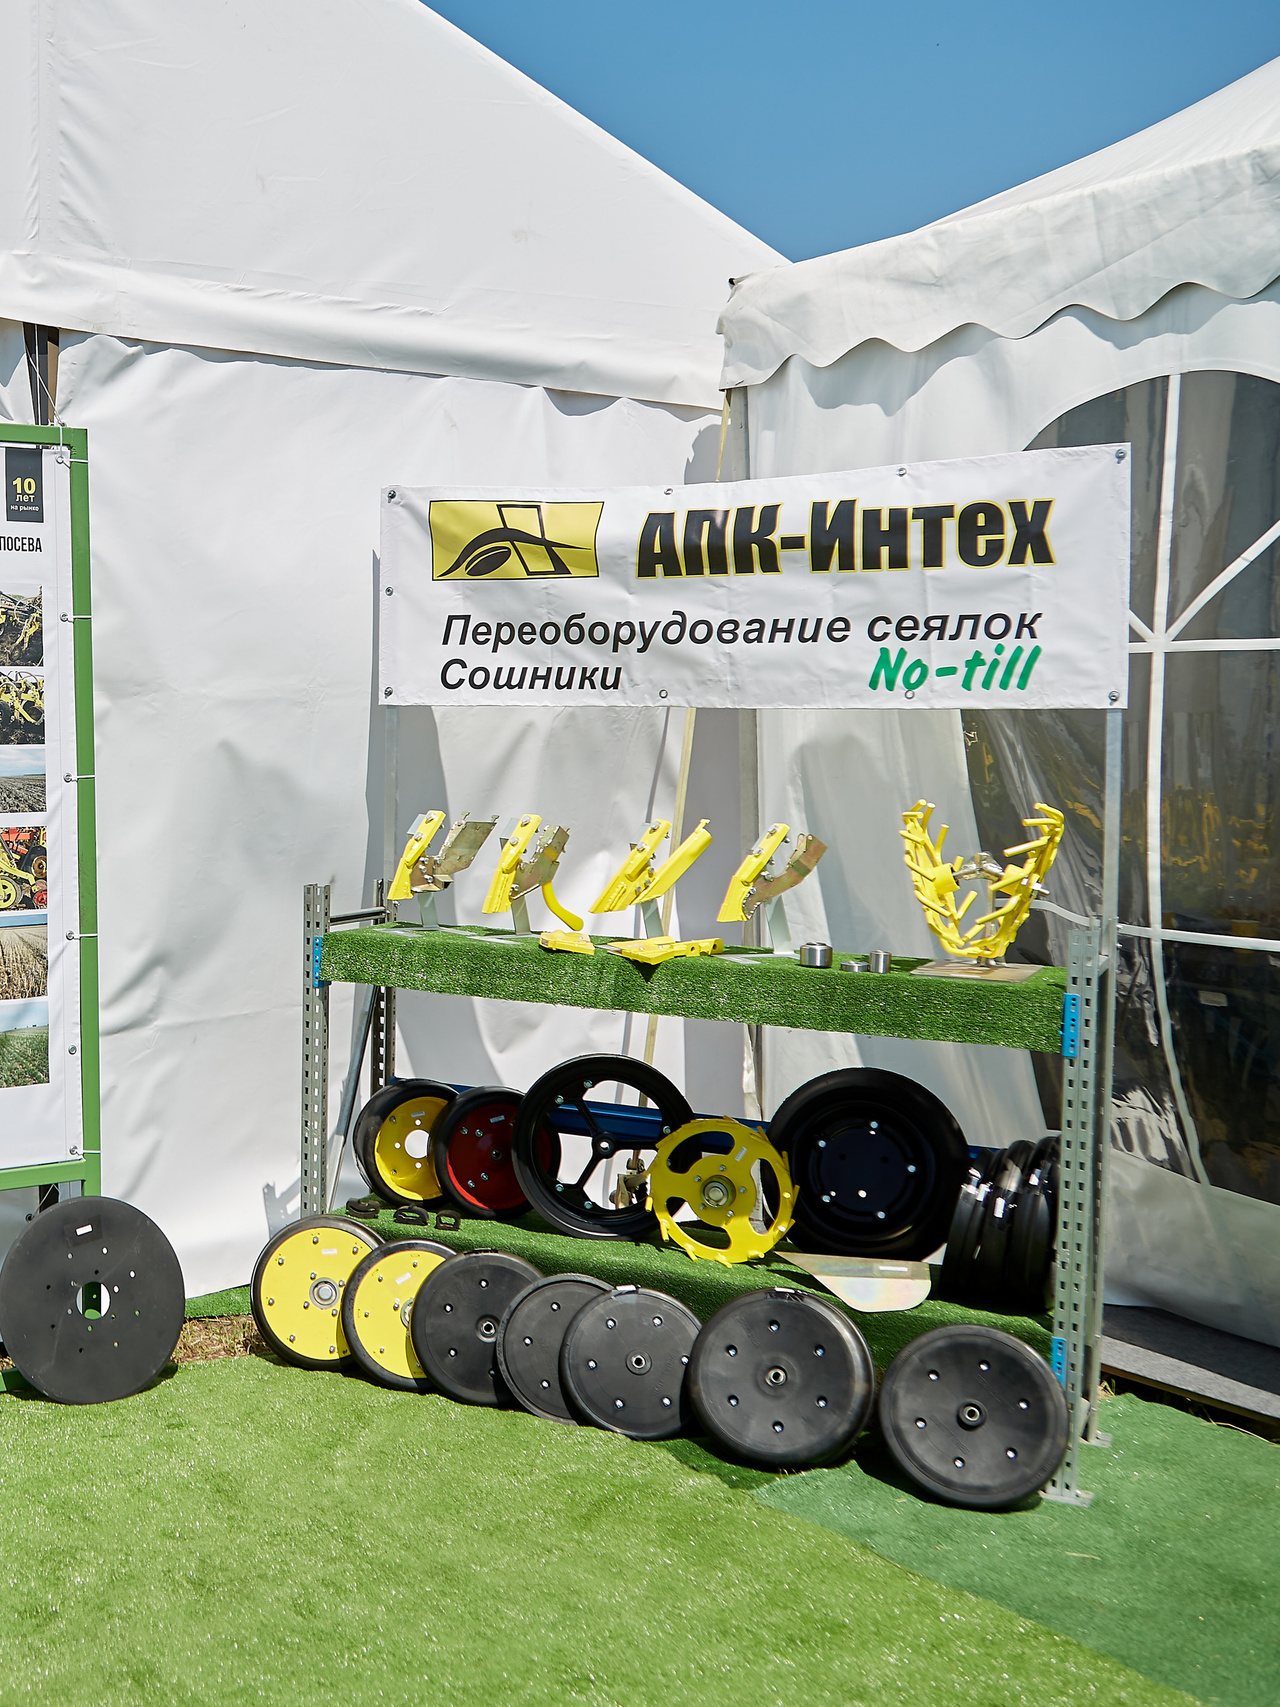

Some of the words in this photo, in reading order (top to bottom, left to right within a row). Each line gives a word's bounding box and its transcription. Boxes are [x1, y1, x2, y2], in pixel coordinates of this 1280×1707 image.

[12, 477, 36, 494] 10
[15, 494, 35, 502] лет
[637, 498, 1056, 578] АПК-Интех
[442, 610, 851, 653] Переоборудование
[867, 612, 1043, 643] сеялок
[440, 658, 623, 690] Сошники
[869, 643, 1043, 691] No-till
